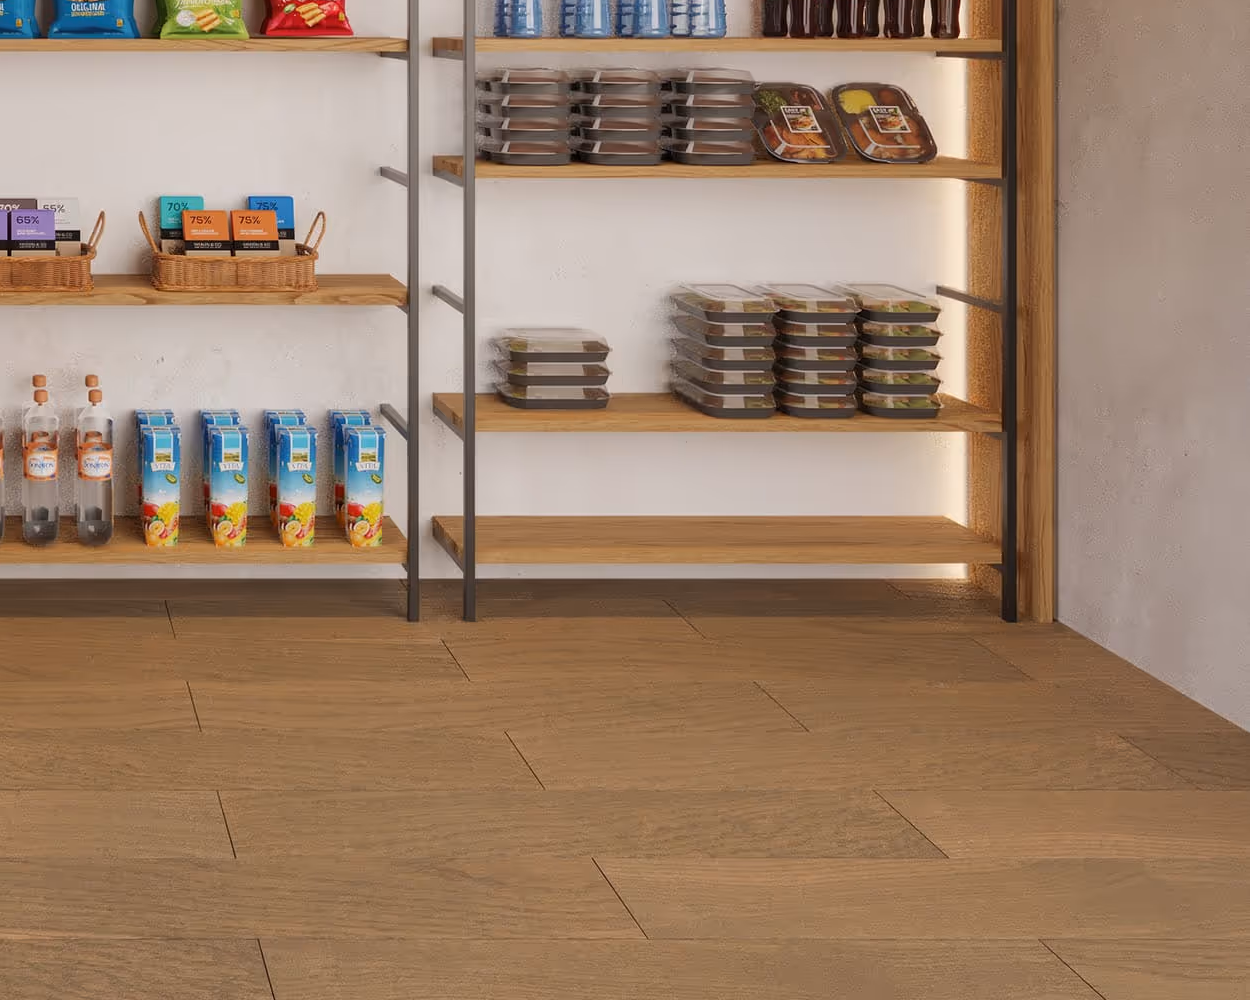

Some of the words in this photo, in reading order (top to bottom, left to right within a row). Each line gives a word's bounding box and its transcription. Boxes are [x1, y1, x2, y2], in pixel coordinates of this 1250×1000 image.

[70, 2, 106, 12] ORIGINAL
[167, 202, 189, 211] 70%
[16, 215, 40, 224] 65%
[190, 215, 212, 225] 75%
[238, 215, 261, 225] 75%
